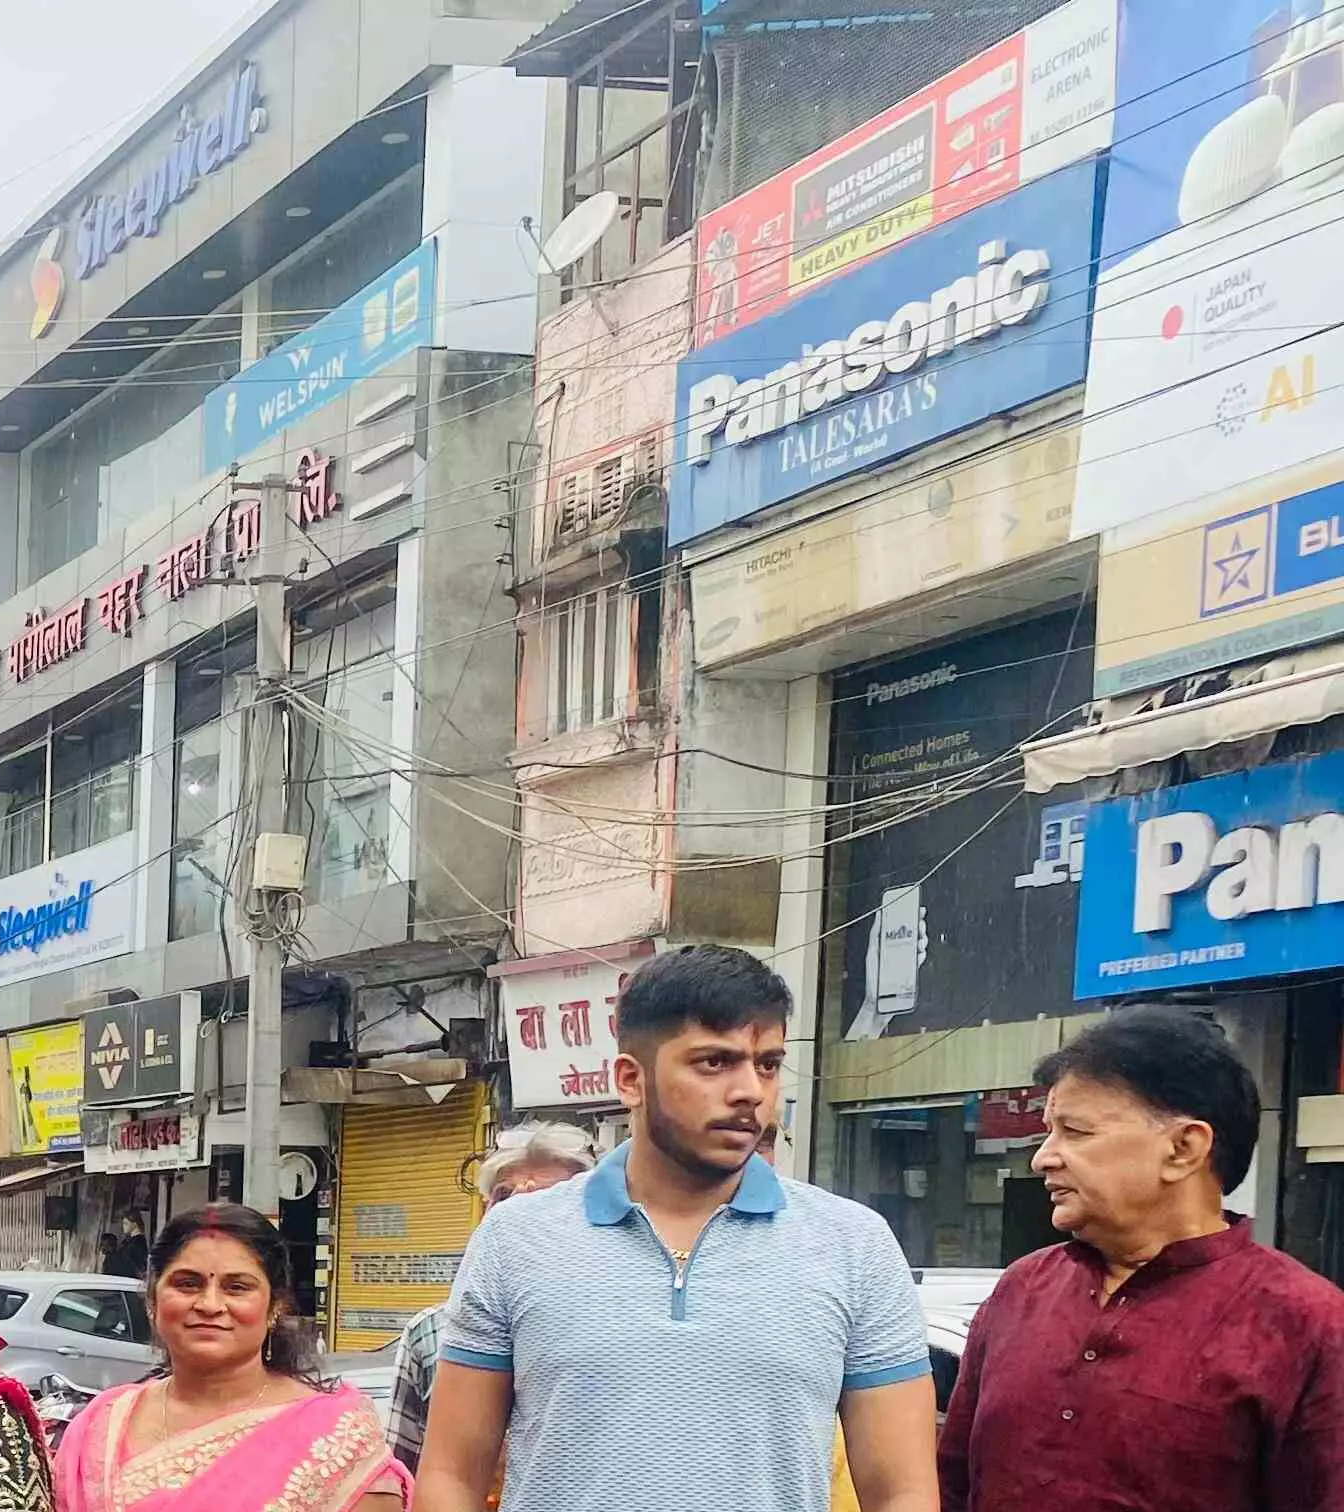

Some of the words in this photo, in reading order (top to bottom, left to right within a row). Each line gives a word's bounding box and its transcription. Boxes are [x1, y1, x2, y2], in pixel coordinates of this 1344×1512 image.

[1045, 66, 1092, 103] ARENA
[826, 134, 925, 202] MITSUBISHI
[800, 233, 860, 278] HEAVY
[865, 202, 920, 244] DUTY
[1203, 281, 1268, 323] QUALITY
[1205, 268, 1252, 303] JAPAN
[687, 239, 1052, 467] Panasonic
[257, 356, 346, 430] WELSPUN
[778, 371, 938, 475] TALESARA'S
[745, 548, 792, 575] HITACHI
[865, 661, 958, 706] Panasonic
[862, 742, 924, 770] Connected
[925, 730, 971, 754] Homes
[1132, 811, 1344, 934] Pan
[1098, 952, 1178, 978] PREFERRED
[1179, 941, 1246, 966] PARTNER
[90, 1046, 131, 1066] NIVIA
